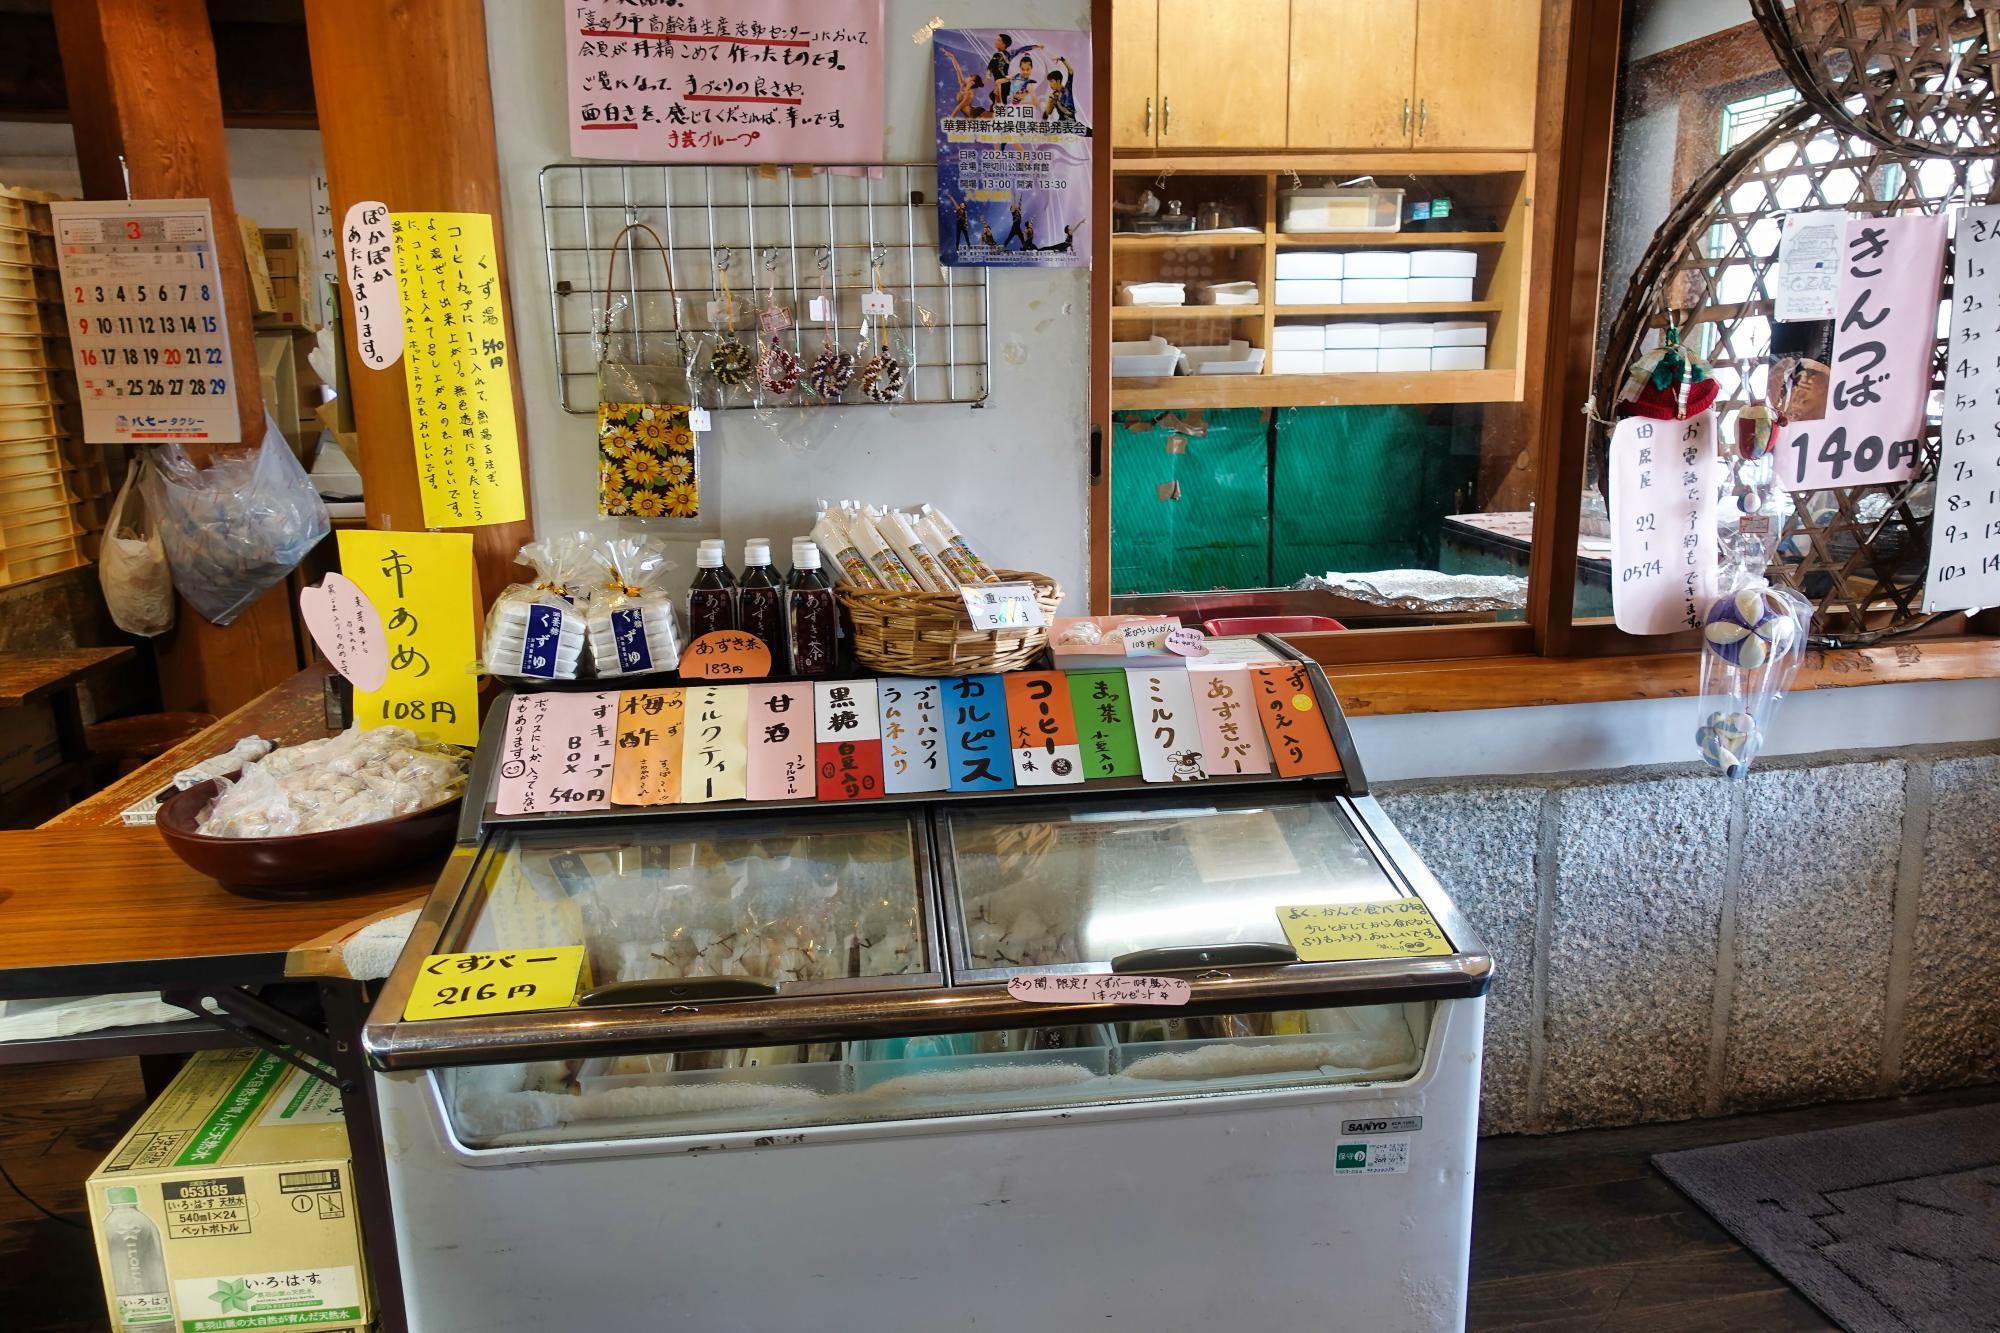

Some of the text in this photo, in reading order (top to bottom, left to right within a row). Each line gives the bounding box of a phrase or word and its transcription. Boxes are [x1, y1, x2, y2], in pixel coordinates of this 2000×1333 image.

[994, 106, 1034, 118] 第21回
[667, 130, 761, 149] 手芸グループ
[959, 150, 1052, 161] 日時 2025年3月30日
[983, 180, 1011, 189] 13:00
[1039, 180, 1067, 190] 13:30
[126, 221, 142, 240] 3
[198, 252, 204, 269] 1
[75, 285, 210, 302] 2 3 4 5 6 7 8
[348, 225, 384, 363] あたたまります。
[79, 316, 216, 334] 9 10 11 12 13 14 15
[1832, 227, 1890, 411] きんつば
[81, 348, 222, 366] 16 17 18 19 20 21 22
[128, 380, 143, 396] 25
[148, 379, 164, 395] 26
[168, 379, 184, 395] 27
[189, 379, 206, 395] 28
[210, 379, 226, 395] 29
[1636, 423, 1654, 490] 田原屋
[1791, 426, 1919, 484] 140円
[381, 550, 430, 677] 市あめ
[804, 594, 825, 662] あずき茶
[533, 613, 550, 669] くずゆ
[622, 610, 641, 665] くずゆ
[696, 636, 761, 655] あずき茶
[1132, 641, 1155, 649] 108円
[705, 663, 744, 676] 183円
[383, 700, 456, 724] 108円
[763, 694, 794, 744] 甘酒
[827, 686, 859, 733] 黒糖
[1026, 680, 1060, 756] コーヒー
[1092, 681, 1121, 724] まっ茶
[1149, 677, 1176, 749] ミルク
[586, 693, 613, 778] くずキューブ
[618, 693, 669, 749] 梅酢
[914, 686, 938, 770] ブルーハワイ
[952, 677, 1003, 783] カルピス
[1207, 677, 1252, 773] あずきバー
[562, 736, 582, 775] BOX
[699, 687, 725, 799] ミルクティー
[1017, 726, 1039, 773] 大人の味
[1090, 731, 1115, 775] 小豆入り
[549, 786, 605, 805] 540円
[786, 761, 798, 795] アルコール
[427, 955, 558, 975] くずバー
[433, 983, 537, 1007] 216円
[1348, 1122, 1387, 1132] SANYO
[179, 1185, 228, 1198] 053185
[219, 1198, 245, 1208] 天然水
[181, 1223, 240, 1236] ペットボトル
